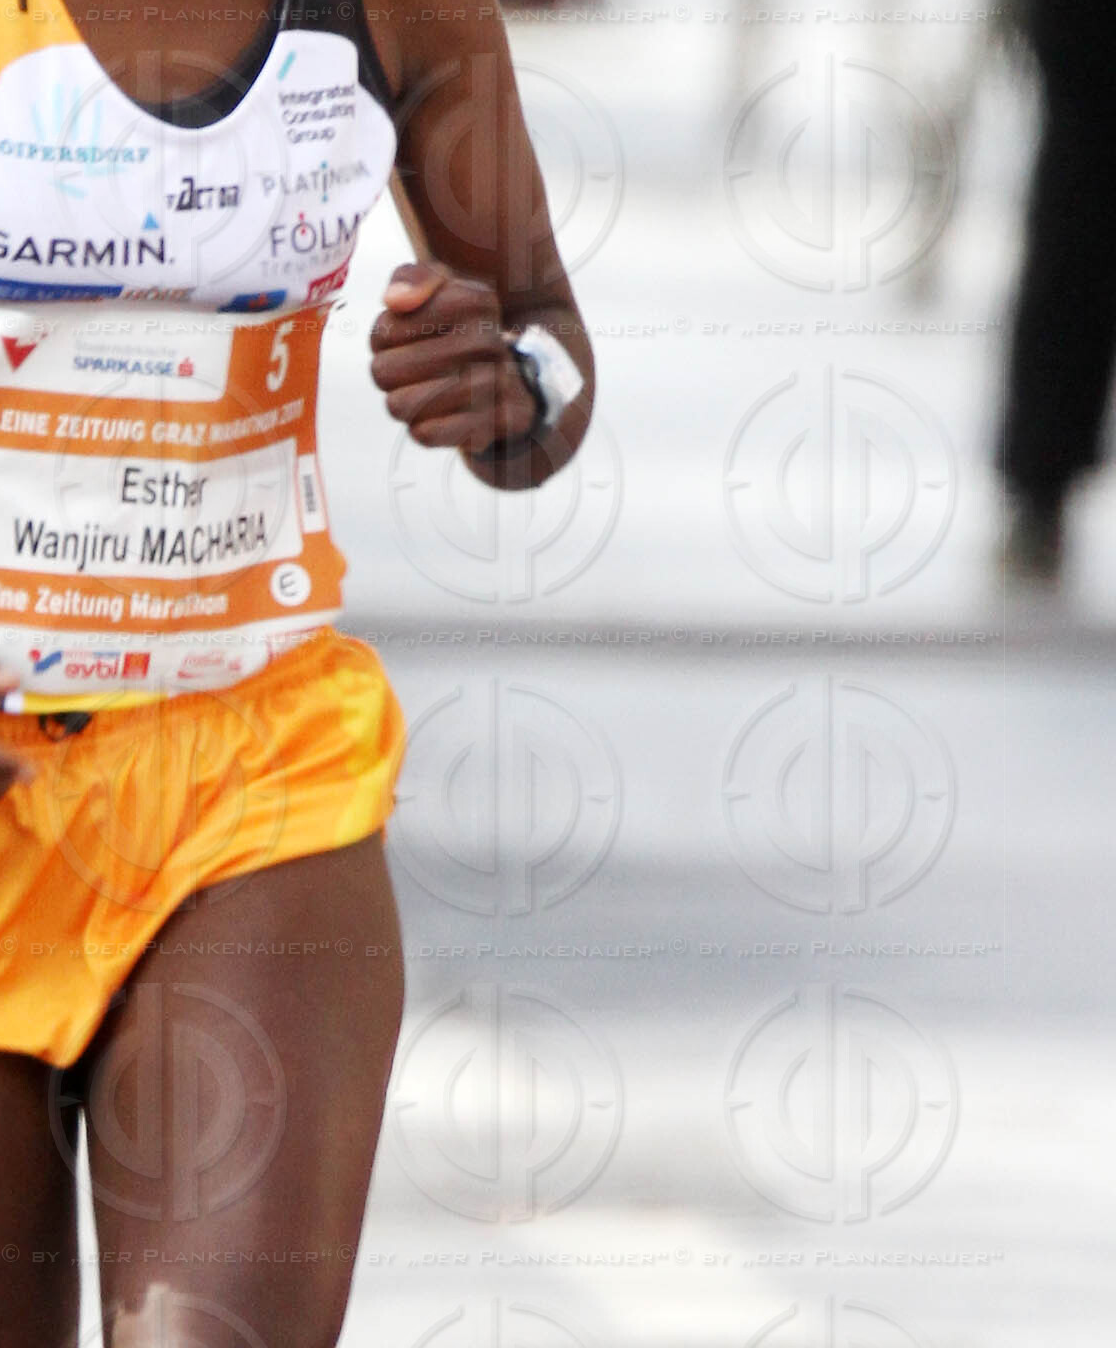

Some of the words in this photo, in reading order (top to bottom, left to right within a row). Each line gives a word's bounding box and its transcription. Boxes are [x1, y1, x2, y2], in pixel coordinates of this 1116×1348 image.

[73, 356, 175, 377] SPARKASSE
[266, 320, 295, 392] 5
[54, 412, 146, 443] ZEITUNG
[151, 420, 208, 447] GRAZ
[121, 467, 208, 507] Esther
[14, 518, 130, 572] Wanjiru
[140, 511, 269, 565] MACHARIA
[279, 570, 298, 597] E
[34, 588, 124, 623] Zeitung
[130, 592, 229, 619] Marathon
